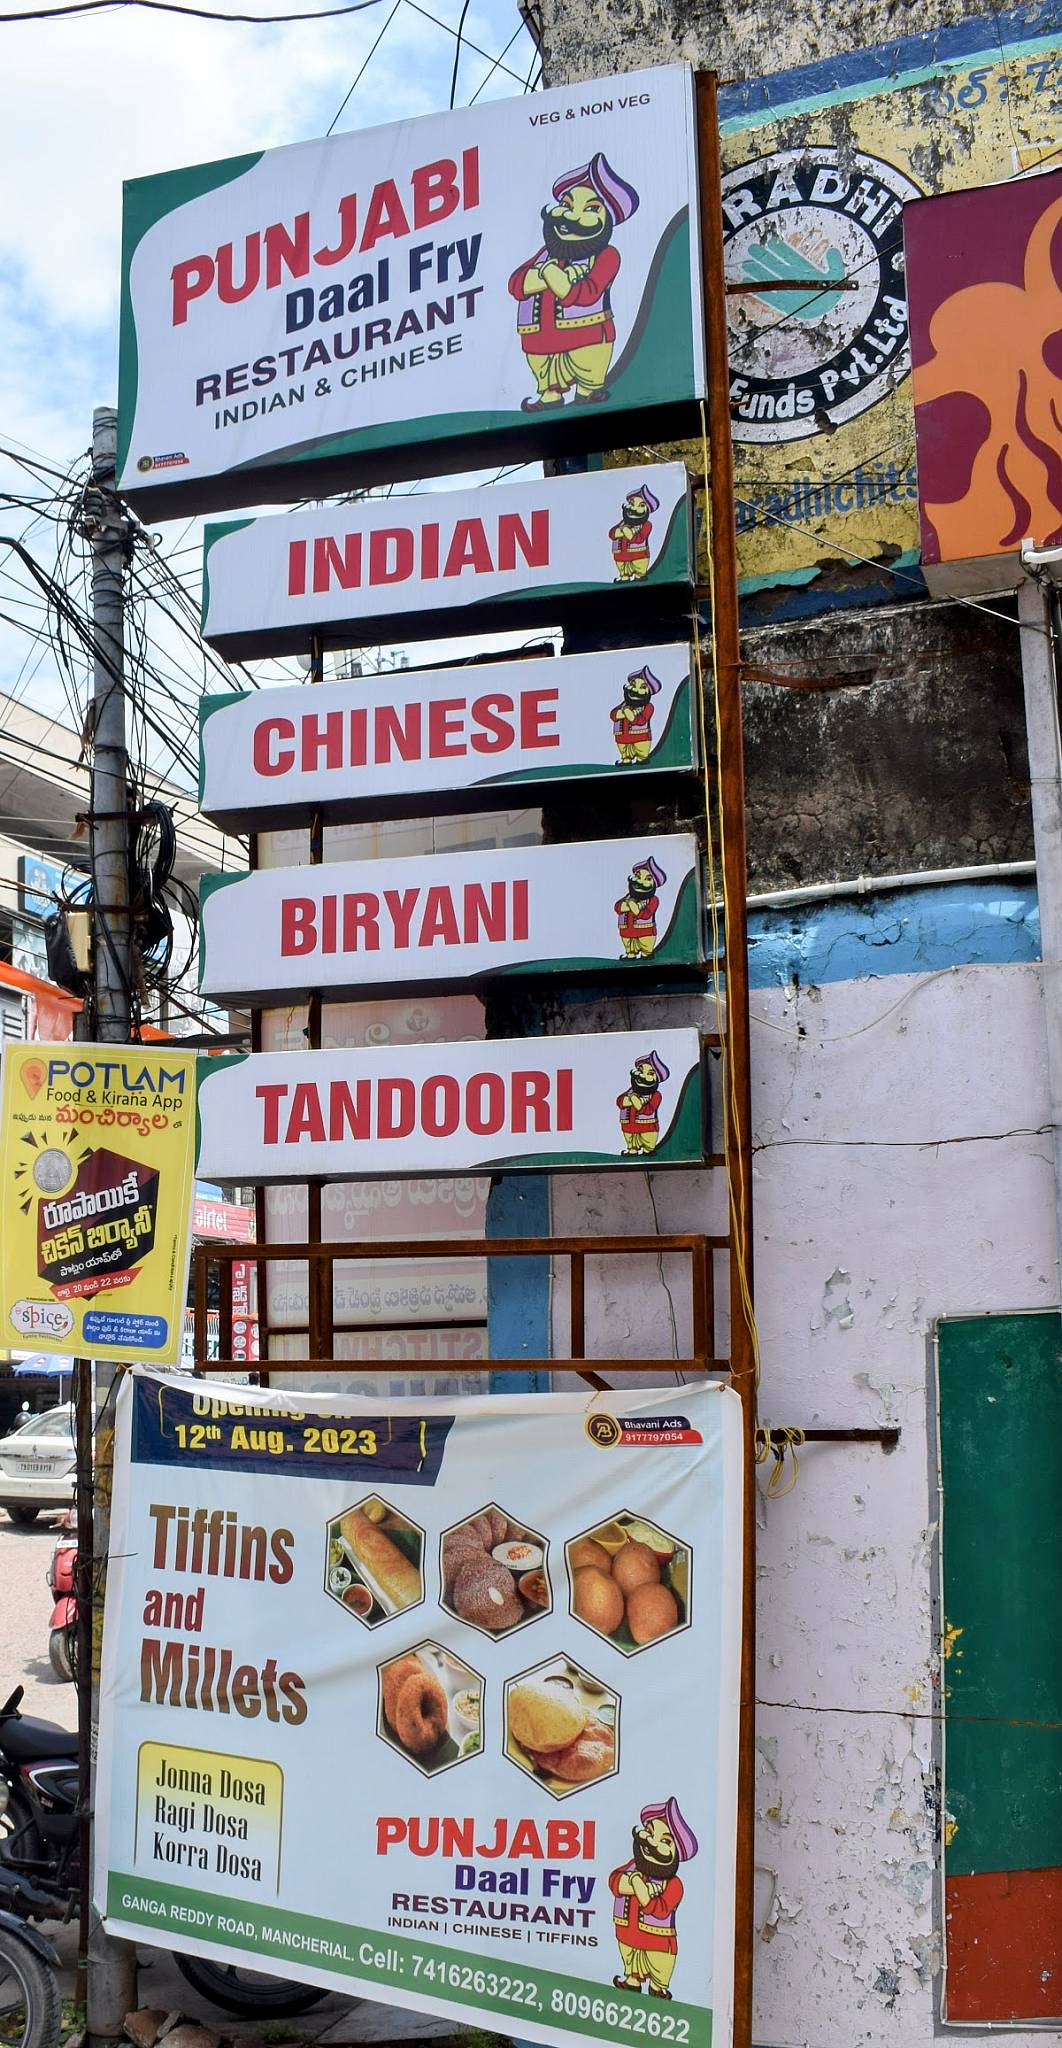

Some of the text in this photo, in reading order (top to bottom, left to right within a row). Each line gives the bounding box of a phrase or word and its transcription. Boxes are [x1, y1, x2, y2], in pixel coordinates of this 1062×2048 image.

[529, 93, 650, 127] VEG & NON VEG
[722, 168, 902, 240] RADHI
[171, 145, 480, 327] PUNJABI
[286, 232, 483, 335] Daal Fry
[195, 286, 484, 407] RESTAURANT
[214, 333, 464, 430] INDIAN & CHINESE
[288, 508, 550, 596] INDIAN
[252, 688, 560, 778] CHINESE
[280, 879, 529, 957] BIRYANI
[47, 1088, 183, 1111] Food & Kirana App
[48, 1060, 186, 1094] POTLAM
[55, 1104, 169, 1137] మంచిర్యాల
[255, 1068, 574, 1145] TANDOORI
[196, 1205, 227, 1231] airtel
[41, 1224, 84, 1265] చికెన్
[73, 1284, 82, 1293] 20
[100, 1278, 111, 1287] 22
[22, 1305, 68, 1331] spice
[174, 1424, 377, 1456] 12th Aug. 2023
[624, 1420, 682, 1429] Bhavani Ads
[625, 1433, 684, 1441] 9177797054
[150, 1503, 295, 1584] Tiffins
[142, 1587, 206, 1632] and
[140, 1638, 308, 1726] Millets
[156, 1759, 266, 1806] Jonna Dosa
[155, 1795, 249, 1840] Ragi Dosa
[375, 1817, 597, 1860] PUNJABI
[153, 1831, 262, 1882] Korra Dosa
[455, 1864, 597, 1904] Daal Fry
[387, 1916, 440, 1932] INDIAN
[452, 1923, 523, 1940] CHINESE
[536, 1930, 599, 1948] TIFFINS
[392, 1892, 596, 1928] RESTAURANT
[121, 1894, 690, 2044] GANGA REDDY ROAD, MANCHERIAL. Cell: 7416263222, 8096622622
